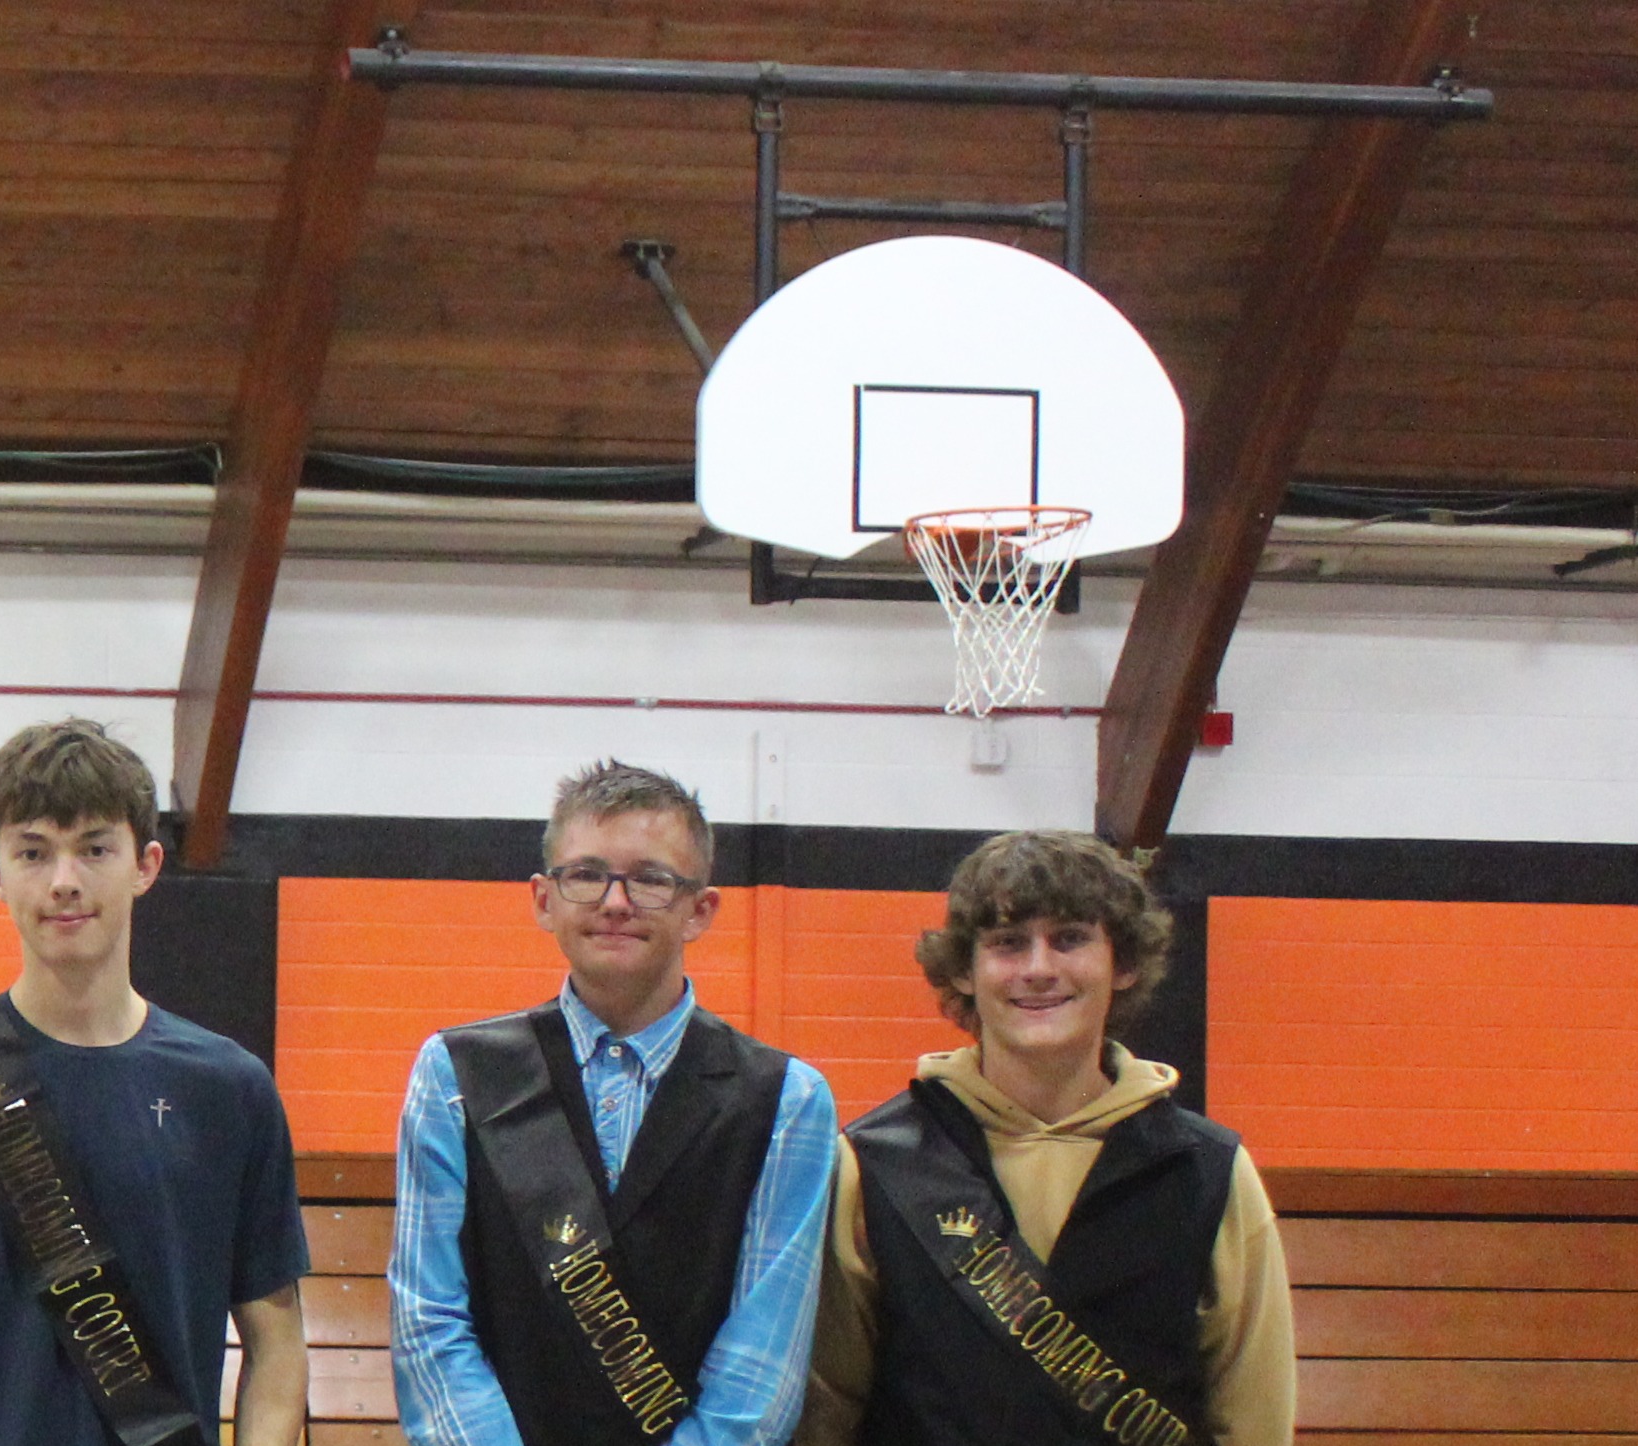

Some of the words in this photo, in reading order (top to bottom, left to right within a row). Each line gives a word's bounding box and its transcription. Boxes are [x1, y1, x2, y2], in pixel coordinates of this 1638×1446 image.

[66, 1292, 152, 1398] COURT
[547, 1239, 690, 1435] HOMECOMING
[954, 1230, 1128, 1412] HOMECOMING
